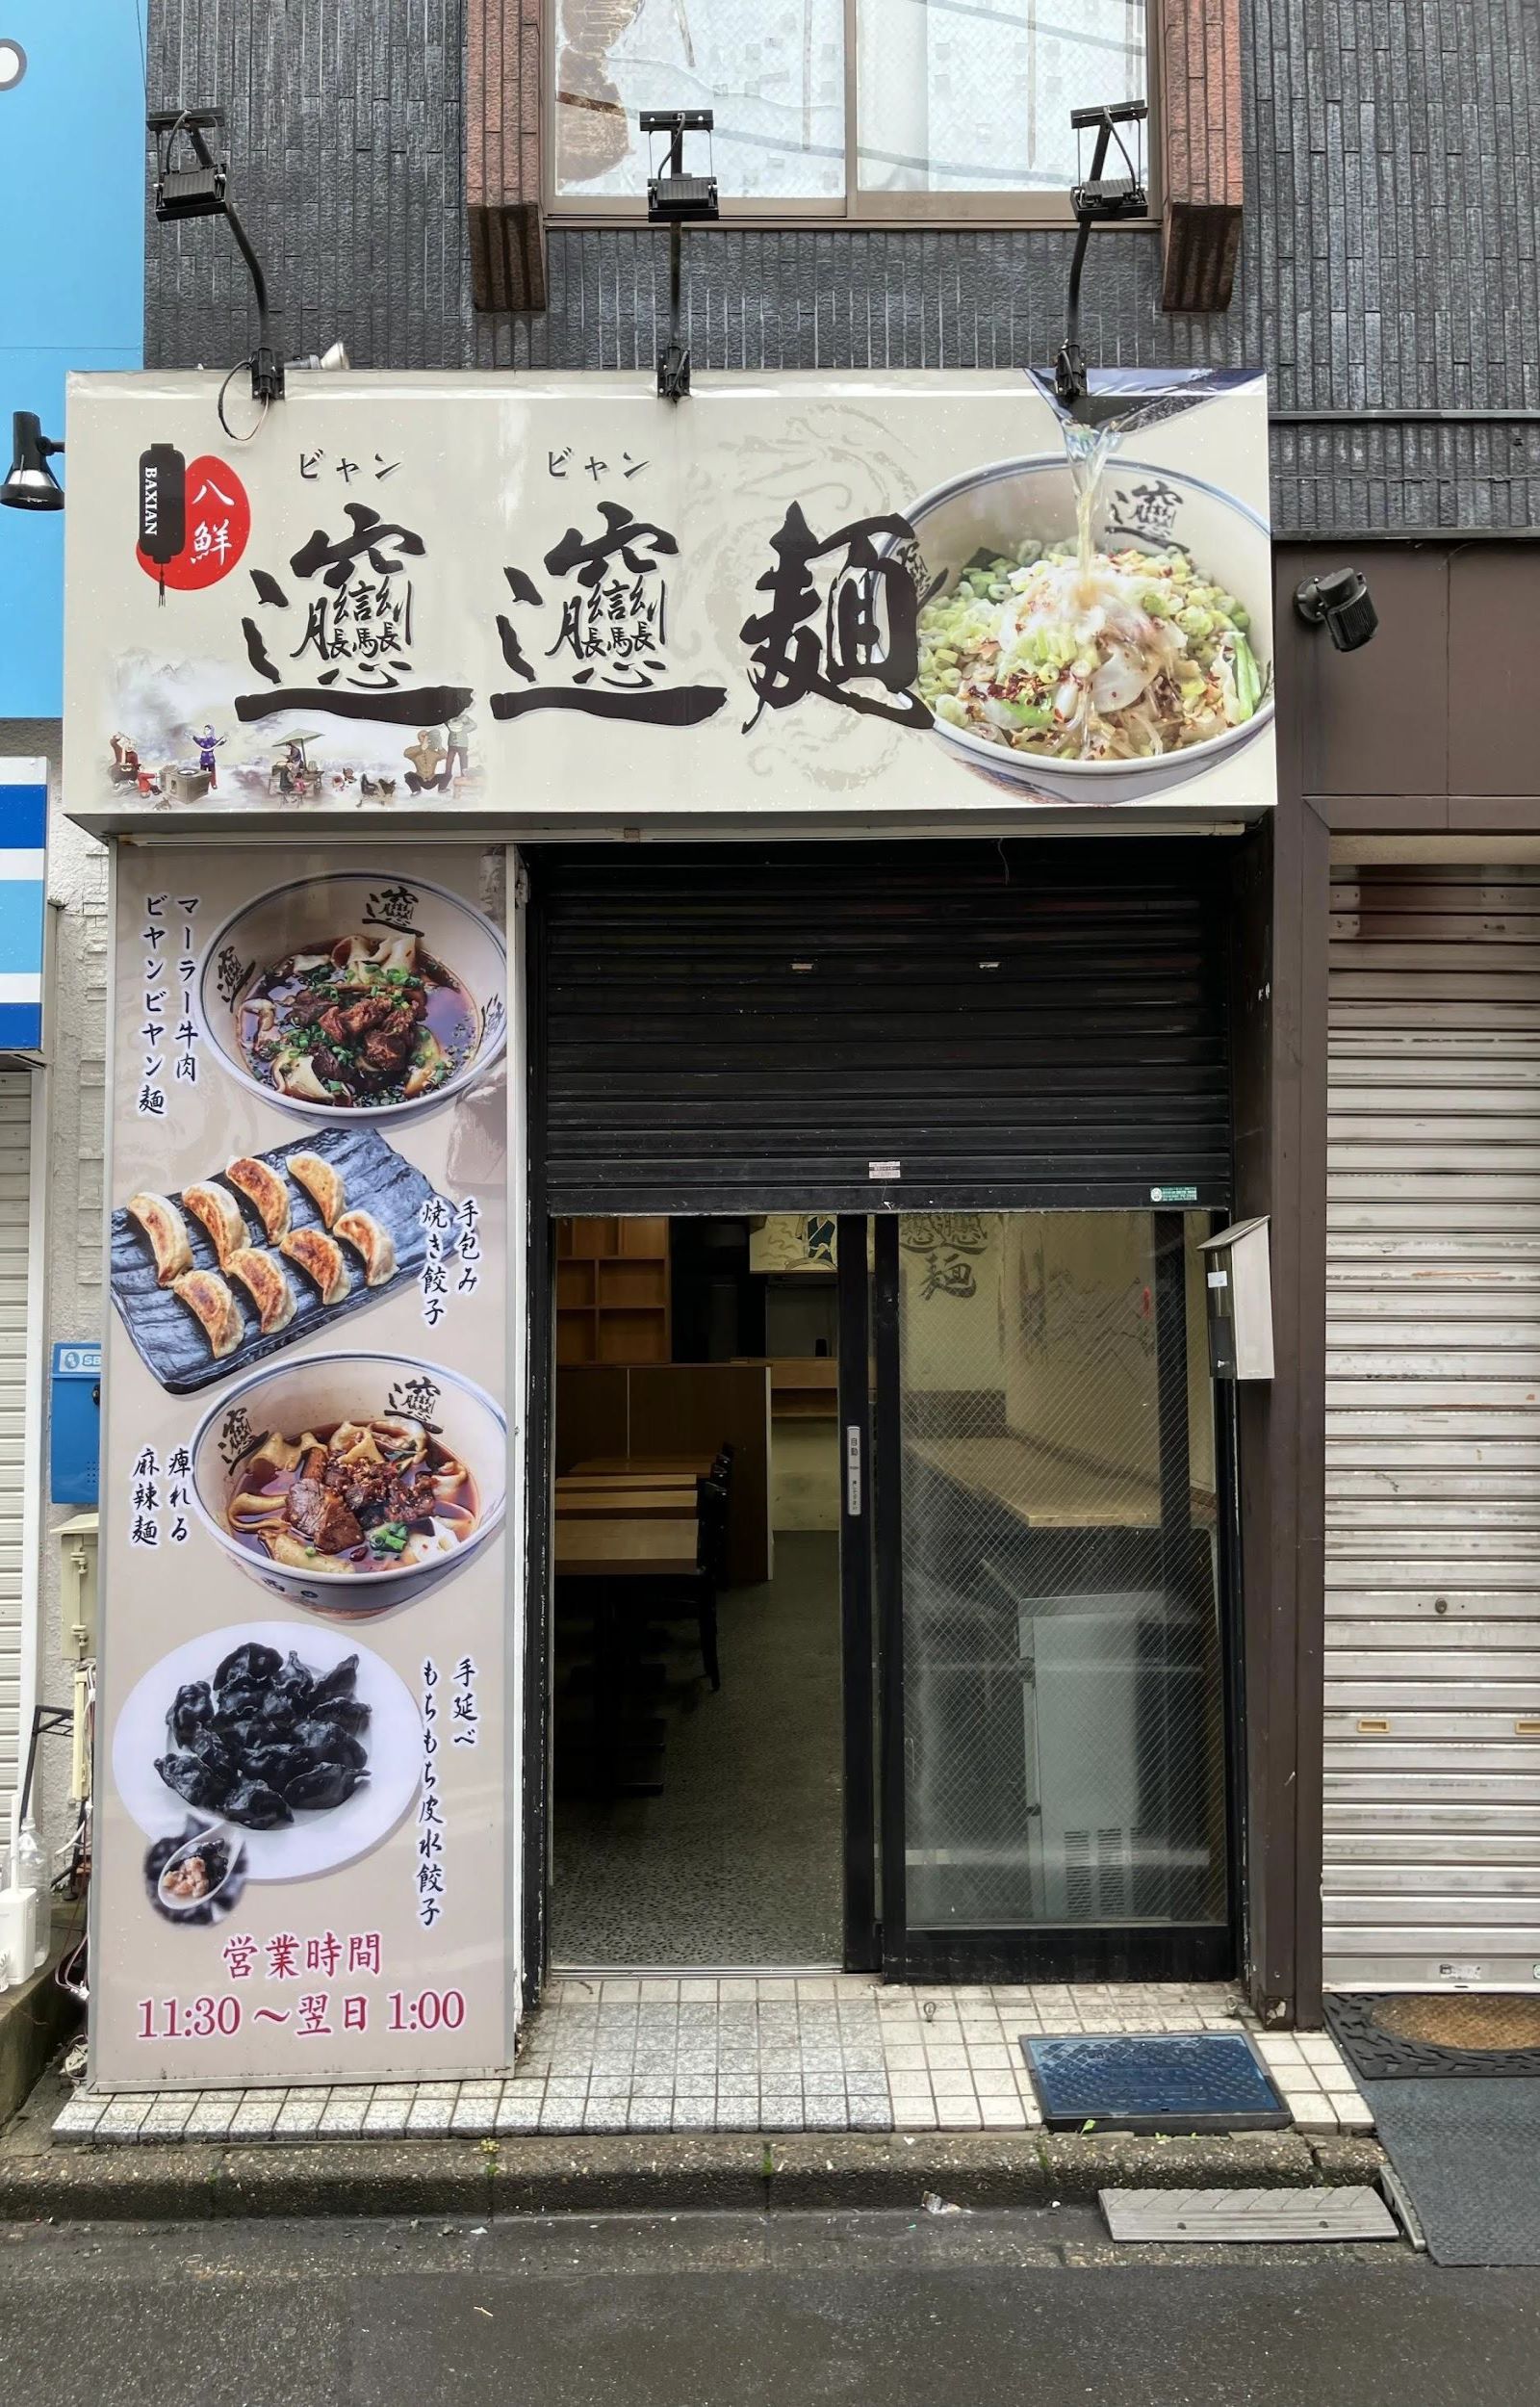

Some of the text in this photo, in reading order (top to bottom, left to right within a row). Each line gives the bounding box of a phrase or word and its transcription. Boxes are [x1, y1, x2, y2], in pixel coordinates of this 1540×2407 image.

[144, 466, 158, 536] BAXIAN
[191, 479, 235, 566] 八鮮
[175, 897, 199, 1082] マーラー牛肉
[422, 1200, 449, 1326] 焼き餃子
[457, 1200, 480, 1292] 手包み
[132, 1448, 160, 1545] 麻辣麺
[168, 1448, 191, 1541] 痺れる
[453, 1658, 478, 1745] 手延べ
[417, 1660, 444, 1927] もちもち皮水餃子
[223, 1931, 381, 1980] 営業時間
[138, 1996, 242, 2038] 11:30
[388, 1990, 465, 2031] 1:00
